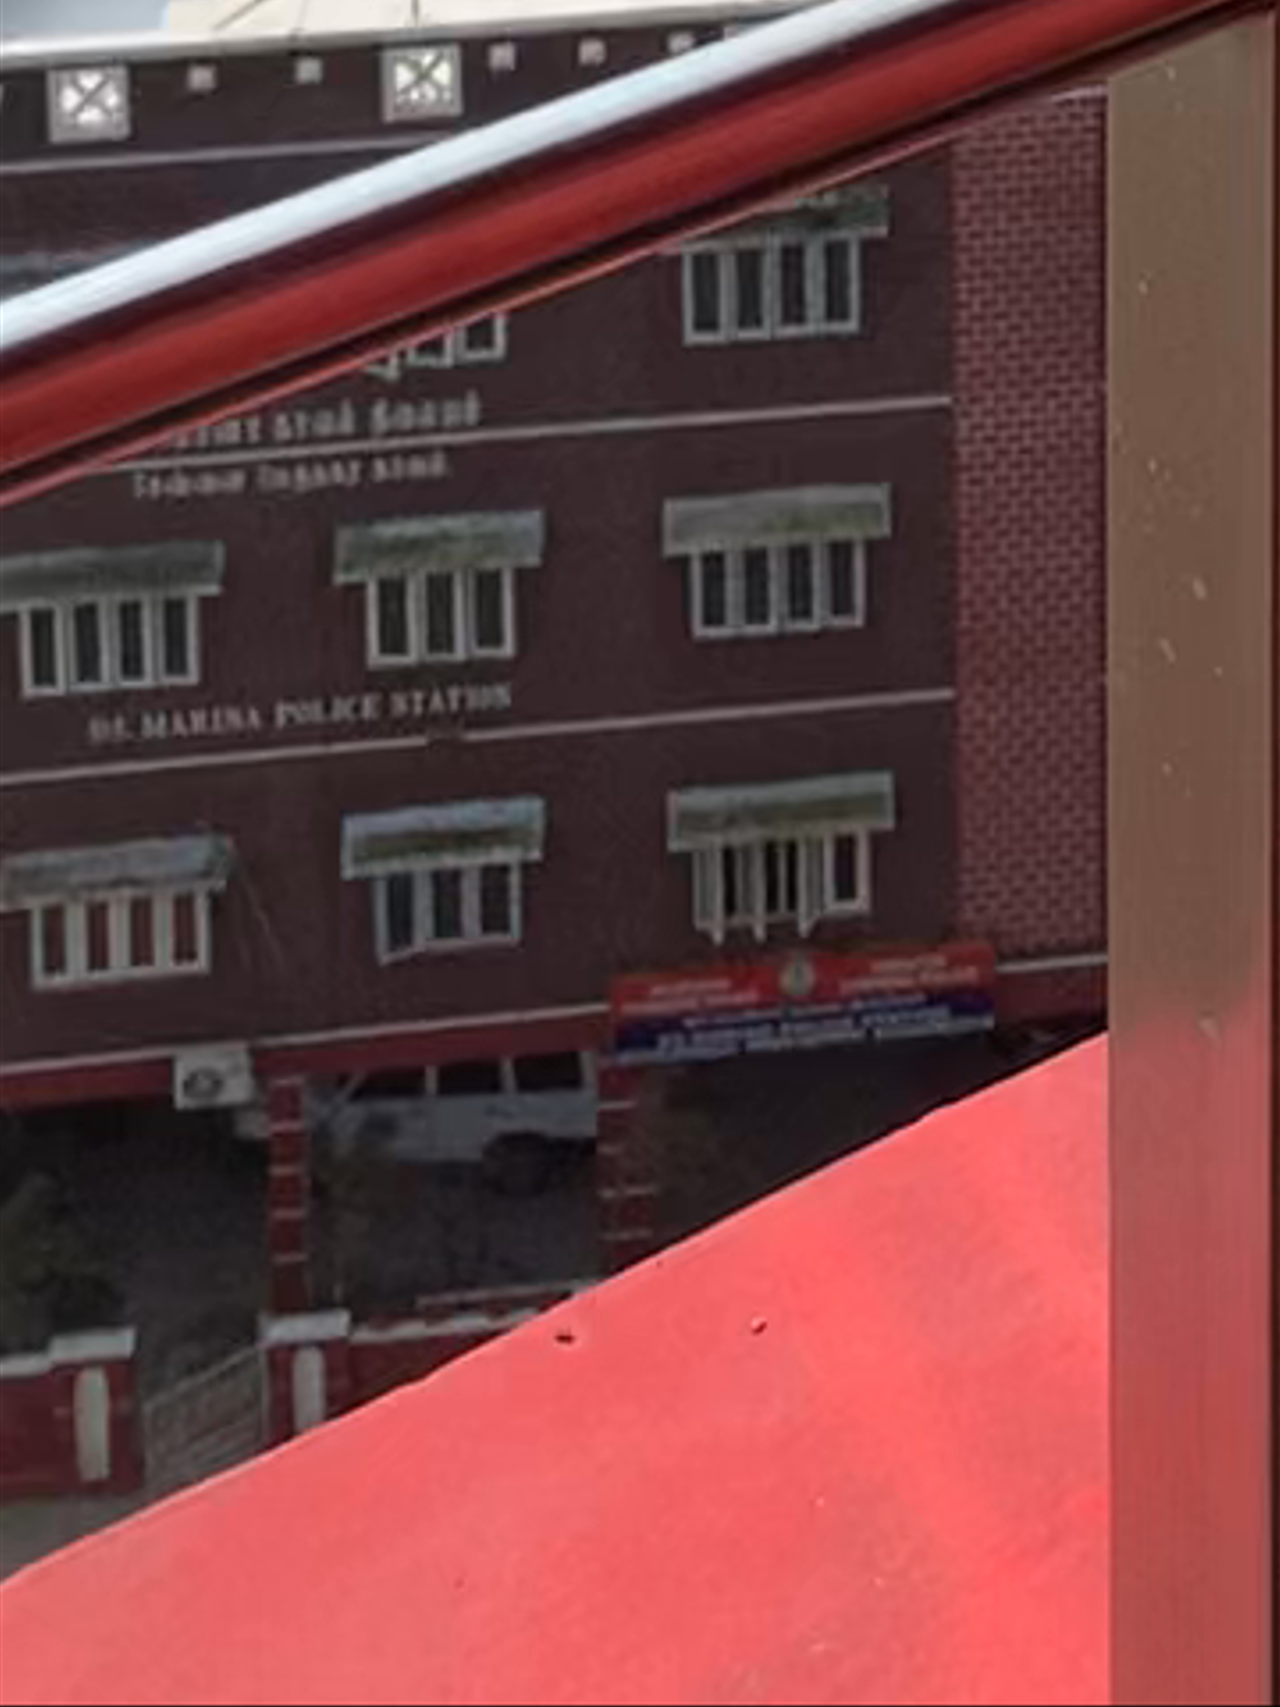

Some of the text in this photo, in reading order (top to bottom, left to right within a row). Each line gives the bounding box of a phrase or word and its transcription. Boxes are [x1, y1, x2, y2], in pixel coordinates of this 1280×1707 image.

[140, 705, 262, 740] MARINA
[275, 692, 378, 728] POLICE
[393, 682, 512, 718] STATION
